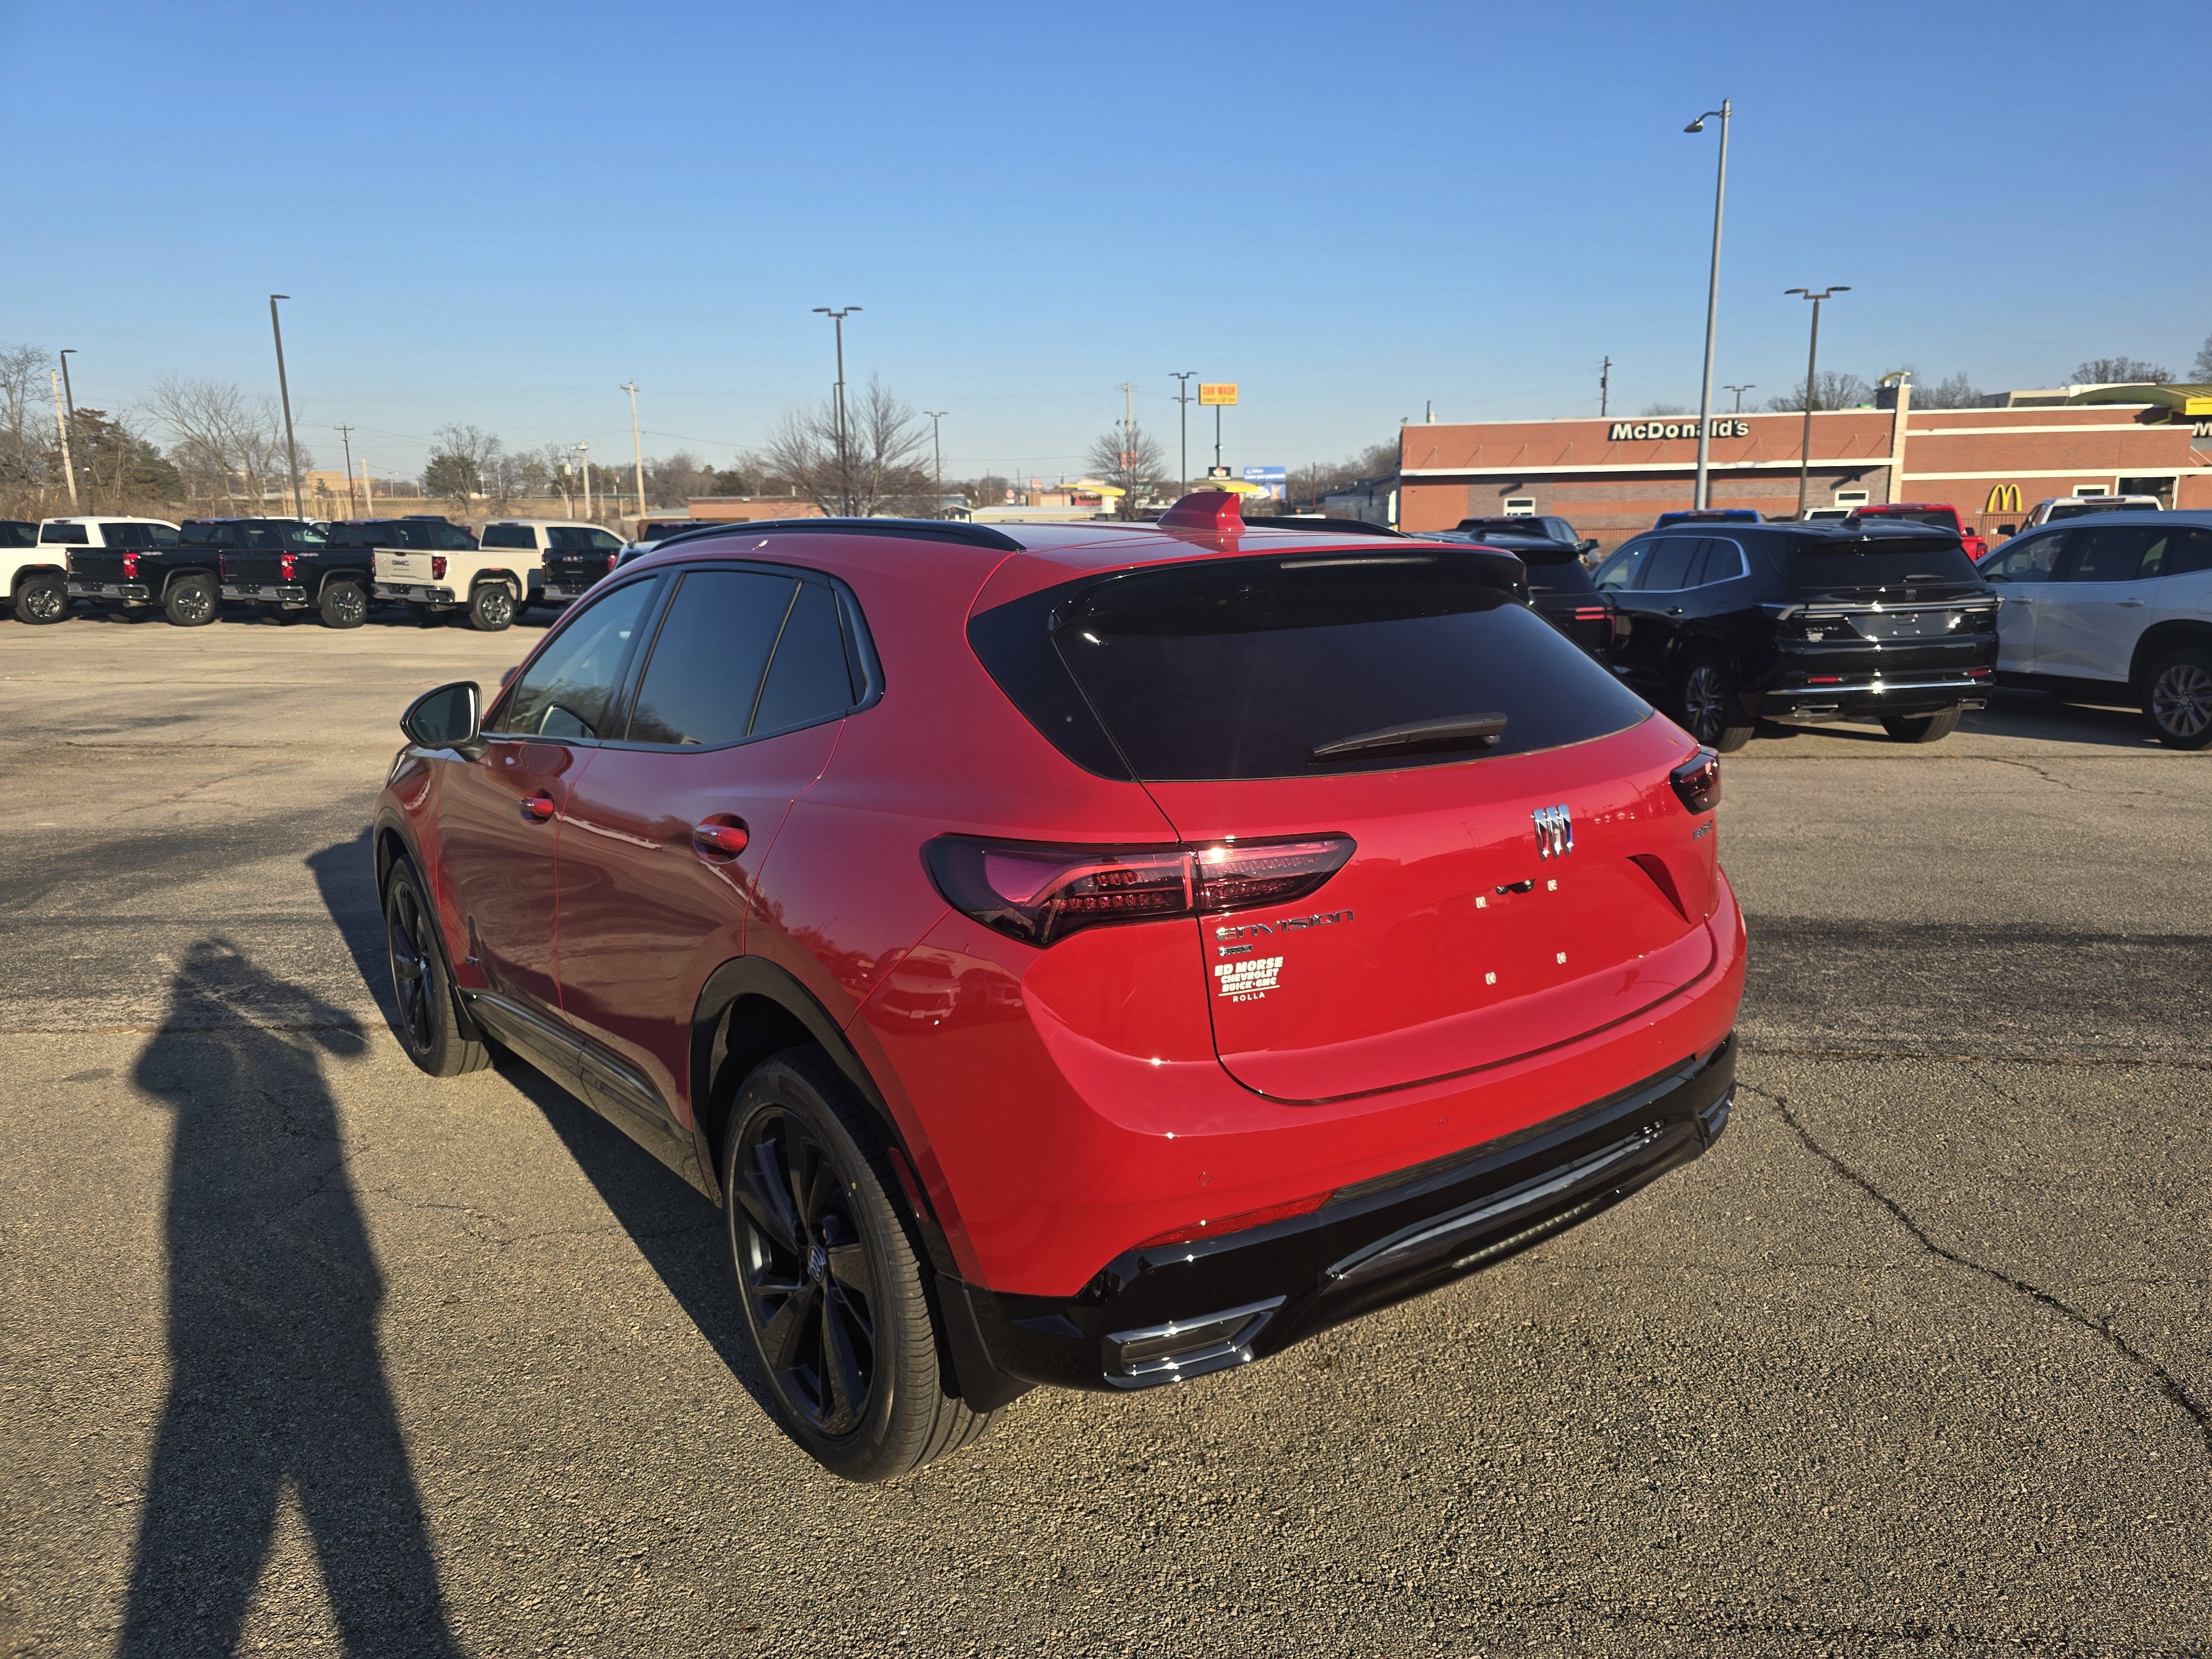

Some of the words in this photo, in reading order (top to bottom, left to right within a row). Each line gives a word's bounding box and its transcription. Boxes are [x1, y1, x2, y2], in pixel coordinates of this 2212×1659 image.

[1214, 963, 1234, 977] ED
[1235, 956, 1284, 974] MORSE
[1220, 968, 1279, 984] CHEVROLET
[1233, 992, 1265, 1003] ROLLA
